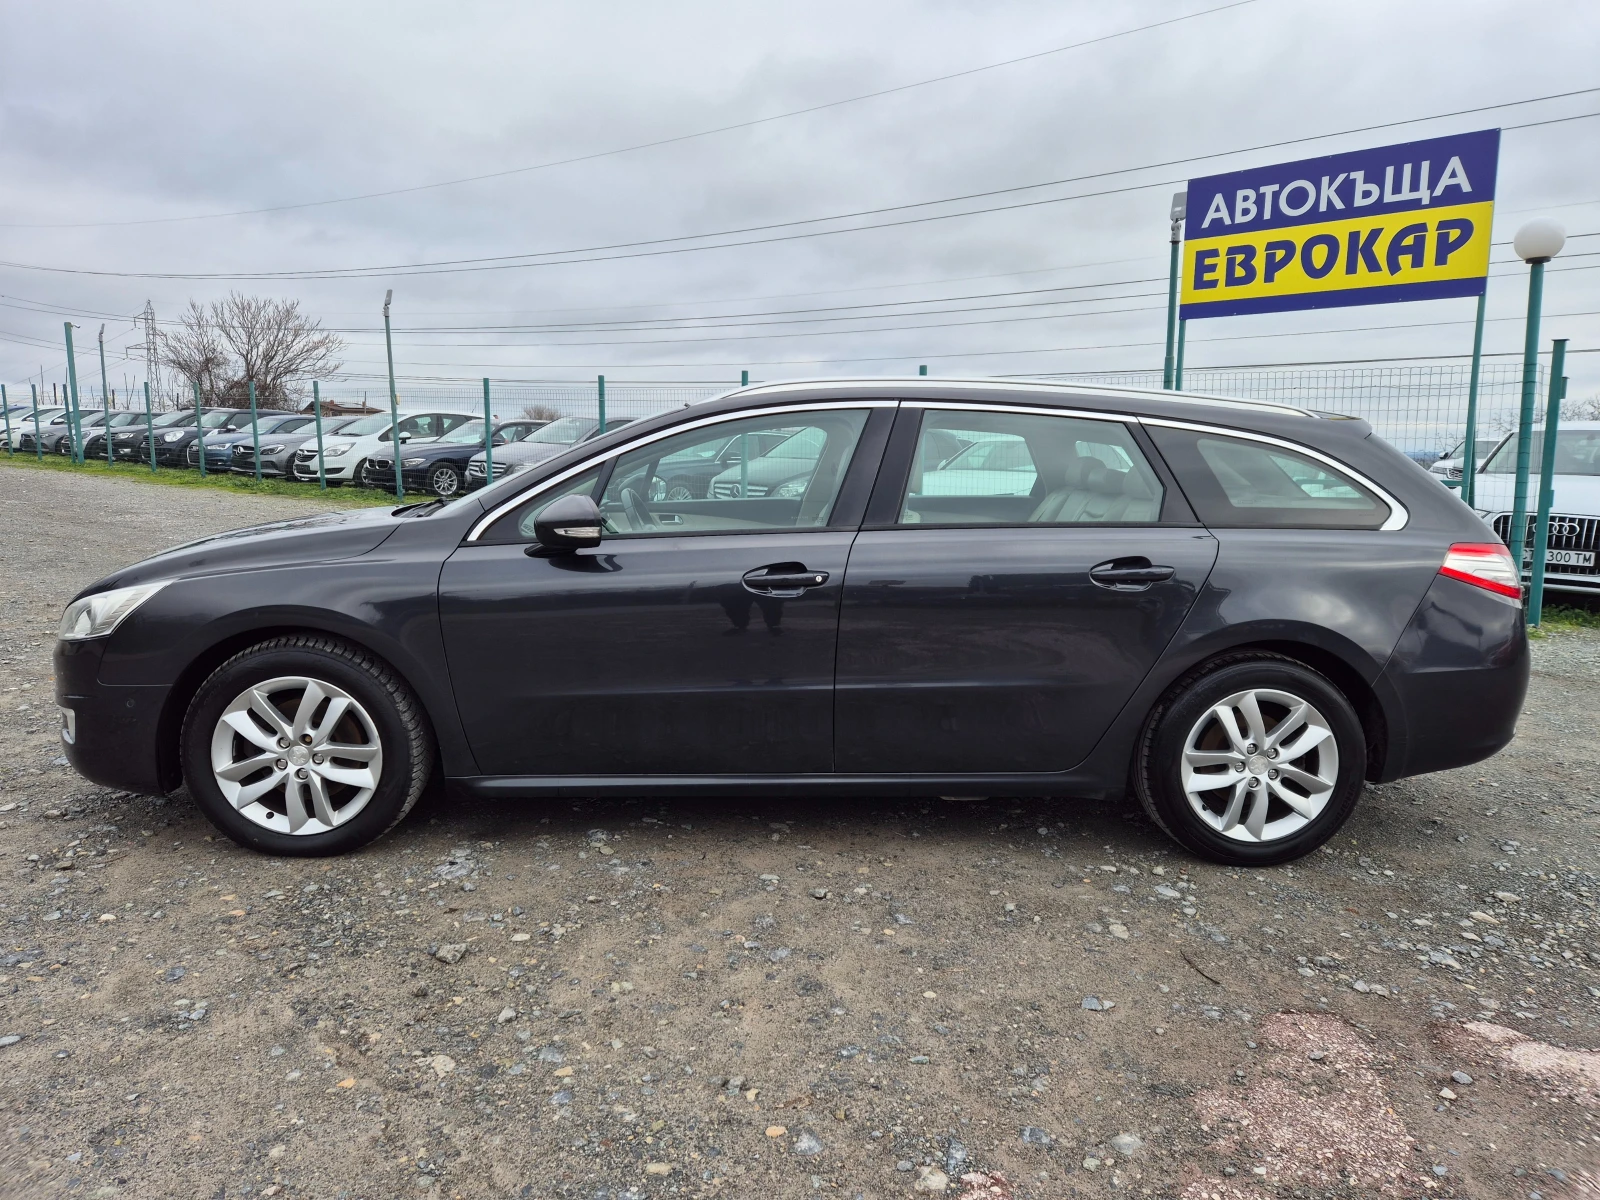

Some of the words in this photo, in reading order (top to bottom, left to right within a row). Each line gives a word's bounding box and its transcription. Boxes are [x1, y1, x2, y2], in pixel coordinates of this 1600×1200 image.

[1201, 156, 1472, 228] АВТОКЪЩА
[1193, 218, 1474, 290] ЕВРОКАР
[1575, 553, 1592, 564] TM
